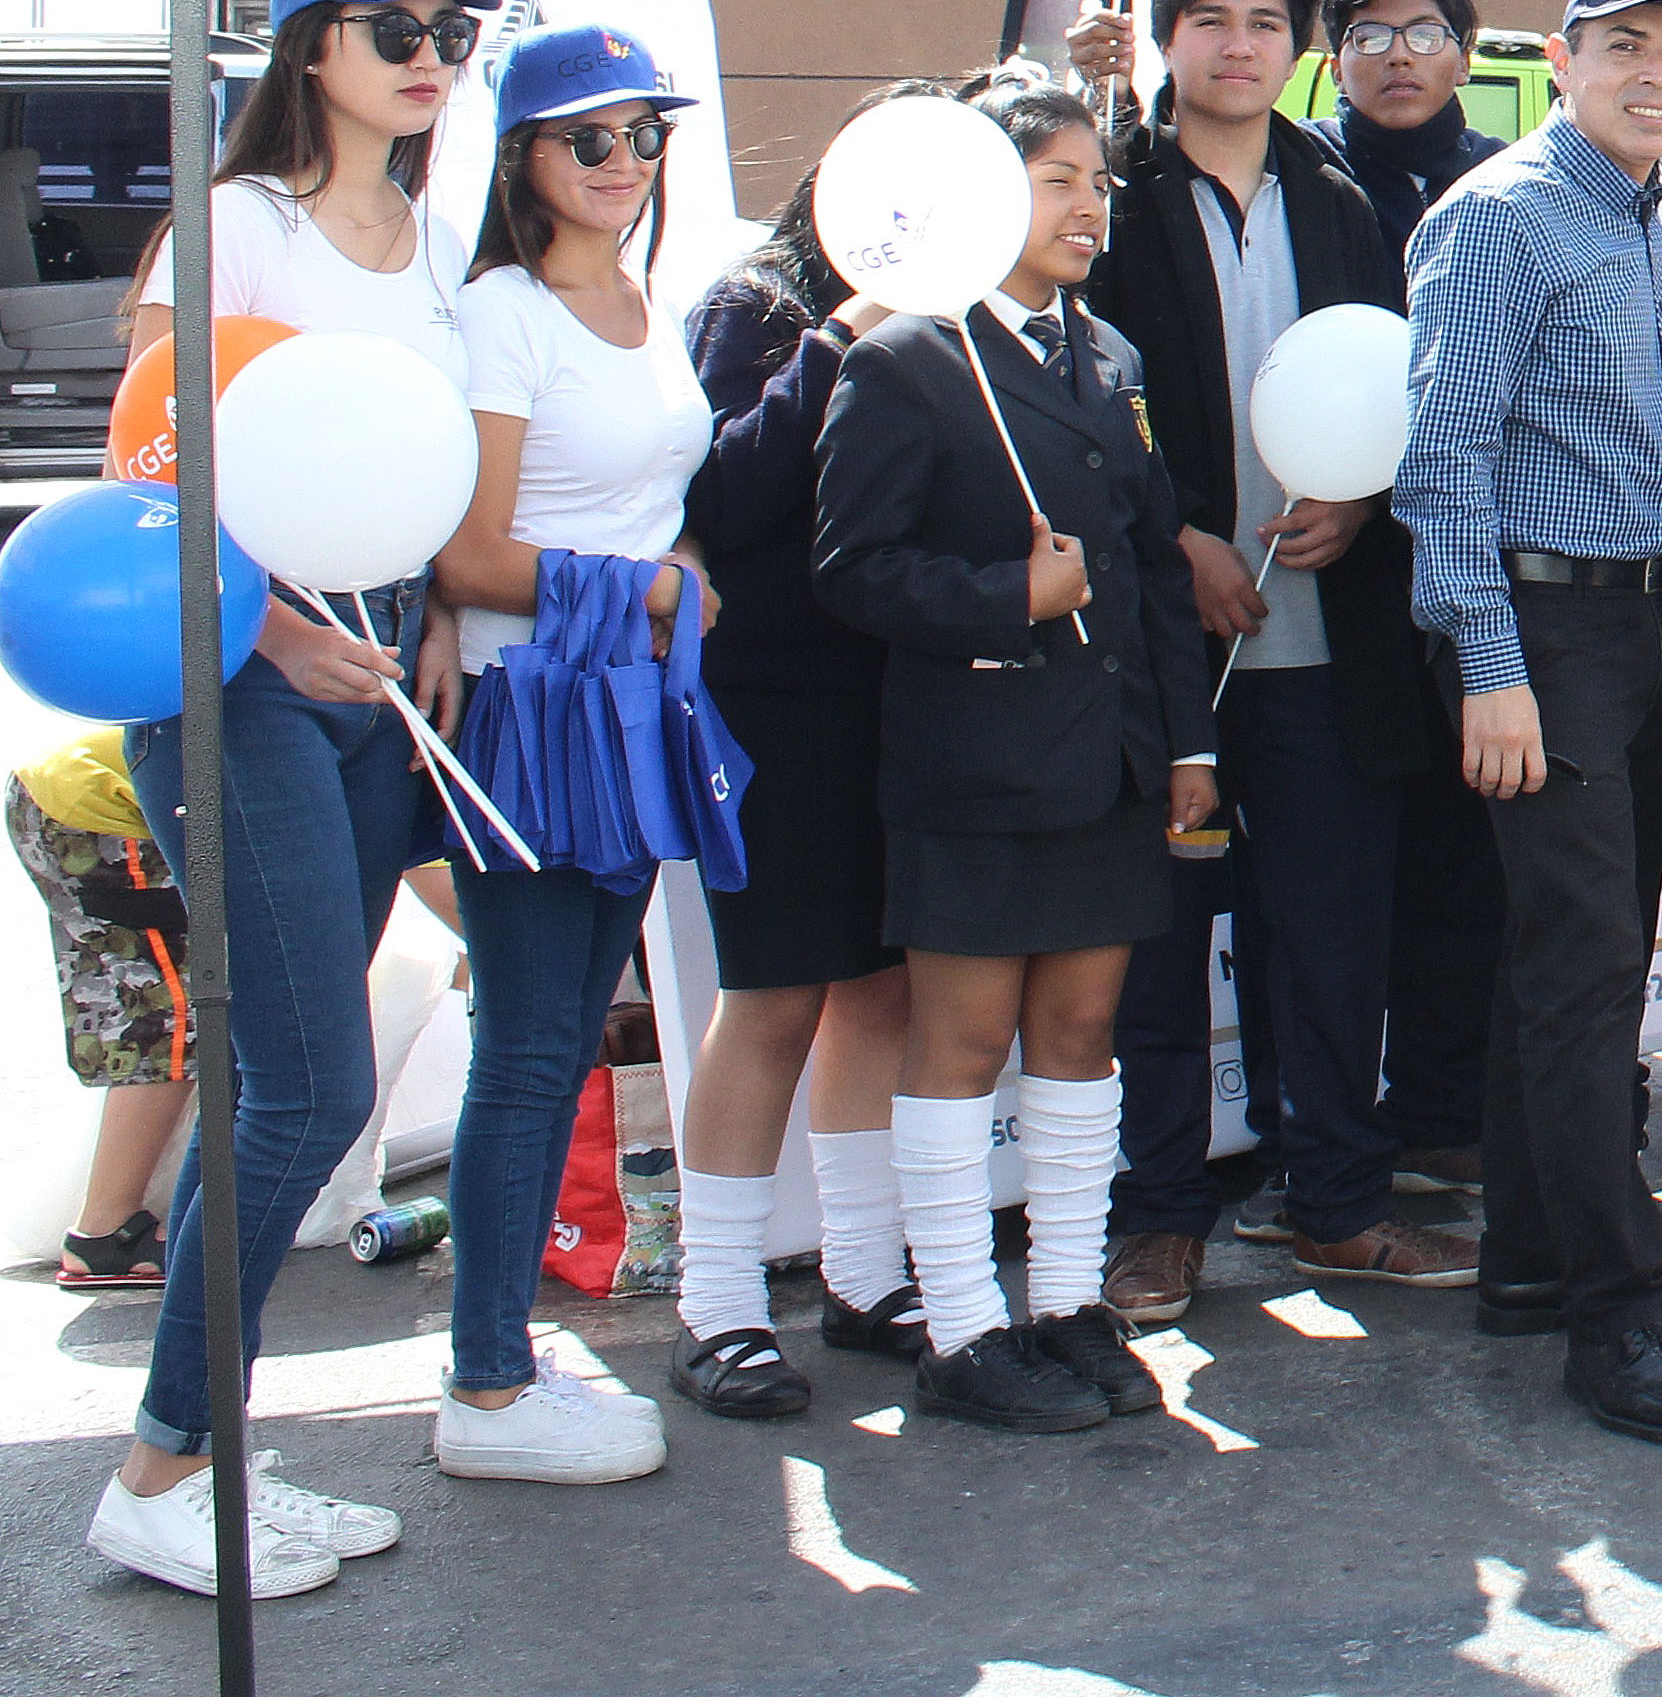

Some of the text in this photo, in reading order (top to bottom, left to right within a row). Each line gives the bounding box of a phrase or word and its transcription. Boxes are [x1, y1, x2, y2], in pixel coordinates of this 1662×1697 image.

[556, 52, 613, 78] CGE
[846, 241, 903, 272] CGE
[125, 432, 178, 482] CGE
